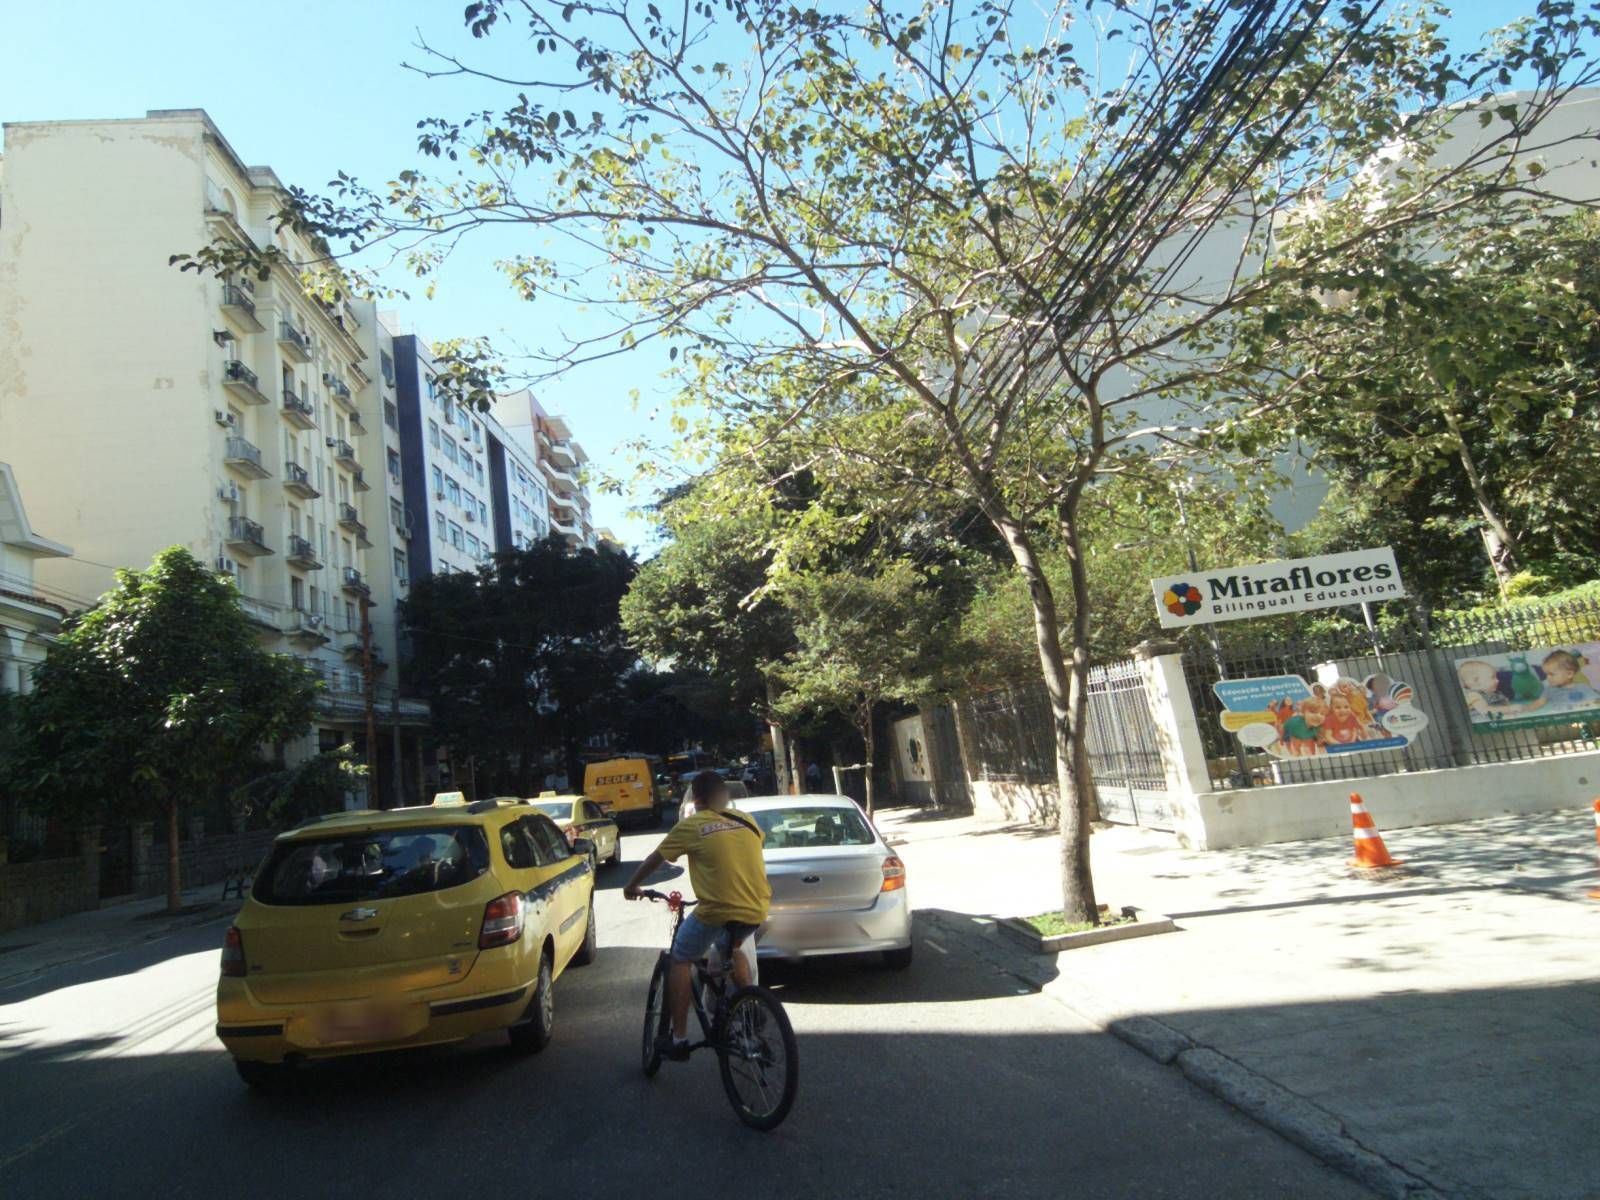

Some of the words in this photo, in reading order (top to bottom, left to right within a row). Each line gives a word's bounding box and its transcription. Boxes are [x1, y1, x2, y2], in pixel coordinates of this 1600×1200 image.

[1207, 562, 1393, 601] Miraflores
[1212, 594, 1296, 615] Bilingual
[1304, 583, 1397, 603] Education
